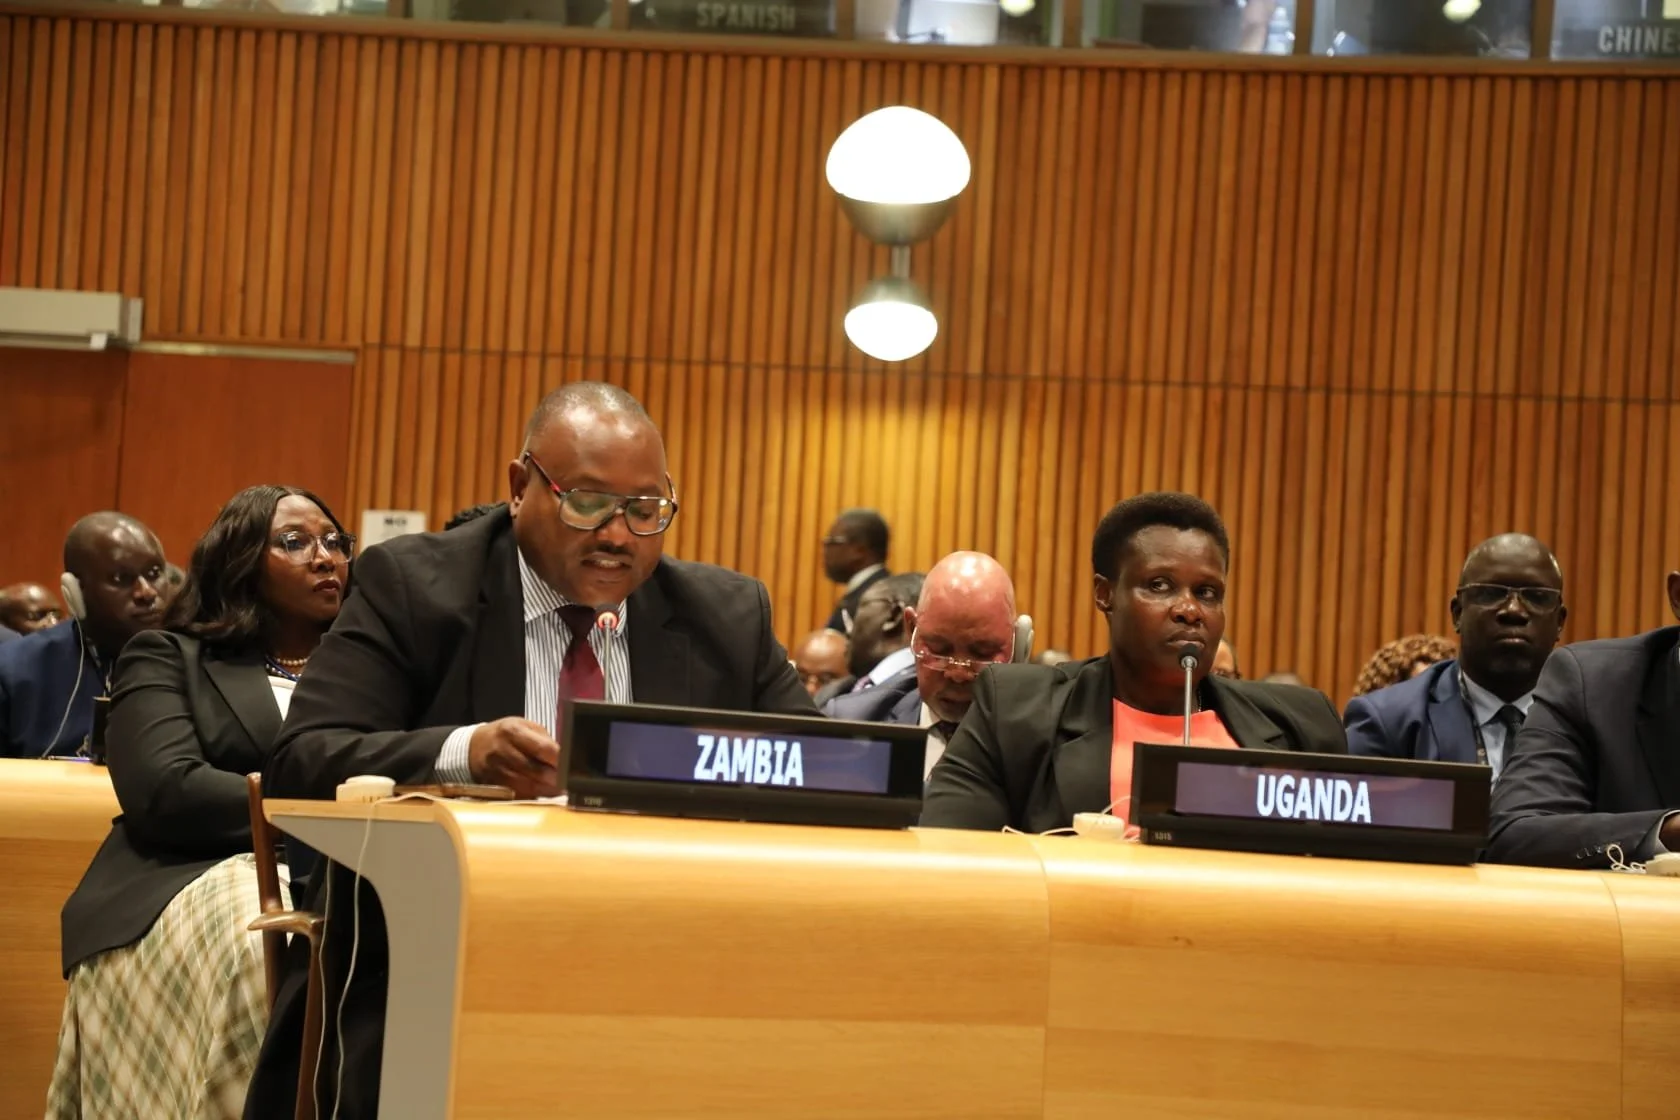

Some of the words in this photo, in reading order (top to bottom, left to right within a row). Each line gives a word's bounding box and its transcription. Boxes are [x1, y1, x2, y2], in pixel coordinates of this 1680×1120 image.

[697, 2, 796, 30] SPANISH
[1598, 25, 1680, 53] CHINE
[694, 734, 804, 786] ZAMBIA
[1256, 774, 1371, 823] UGANDA
